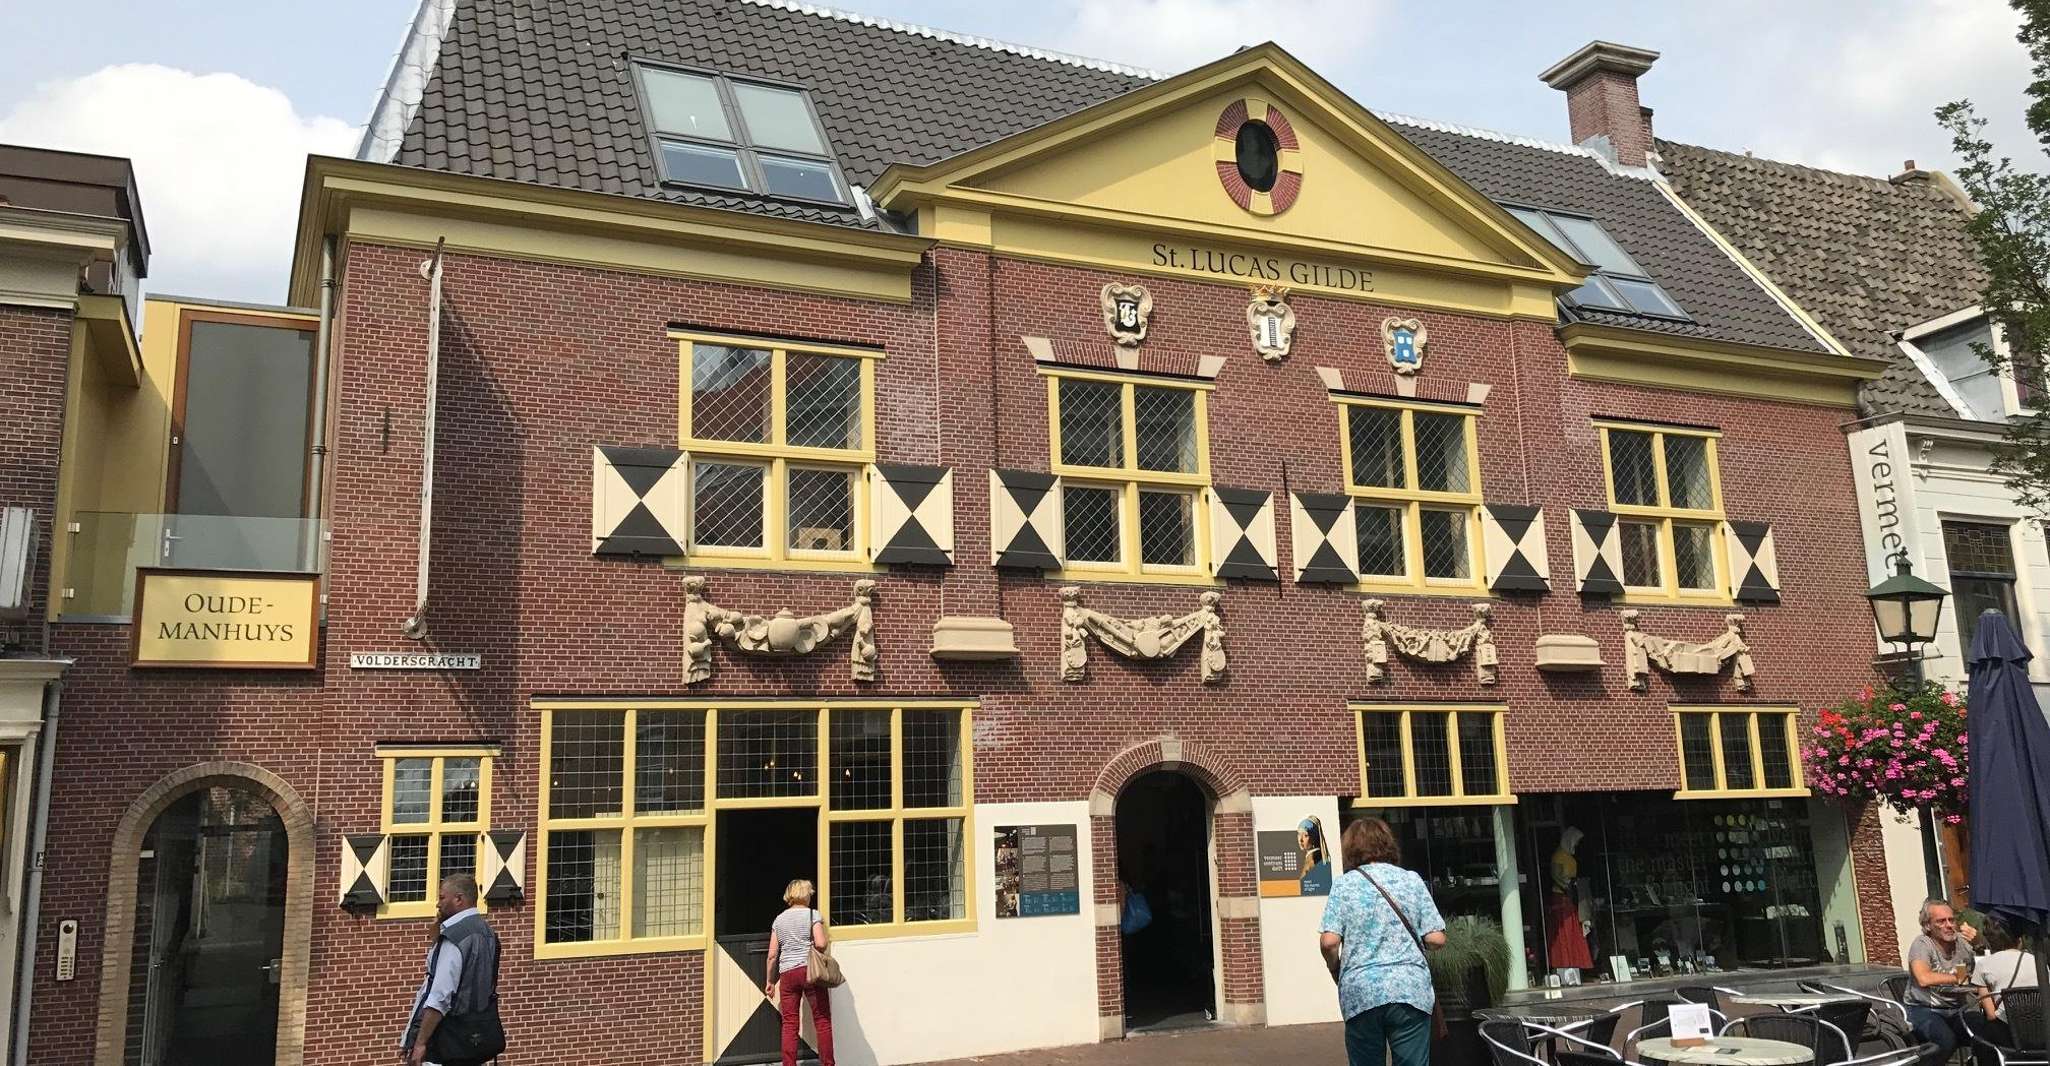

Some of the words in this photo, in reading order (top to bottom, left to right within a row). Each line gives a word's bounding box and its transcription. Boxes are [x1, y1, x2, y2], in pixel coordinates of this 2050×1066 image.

[1289, 262, 1375, 293] GILDE
[1868, 438, 1902, 580] vermee
[184, 593, 274, 615] OUDE-
[157, 621, 294, 642] MANHUYS
[356, 655, 477, 668] VOLDERSGRACHT
